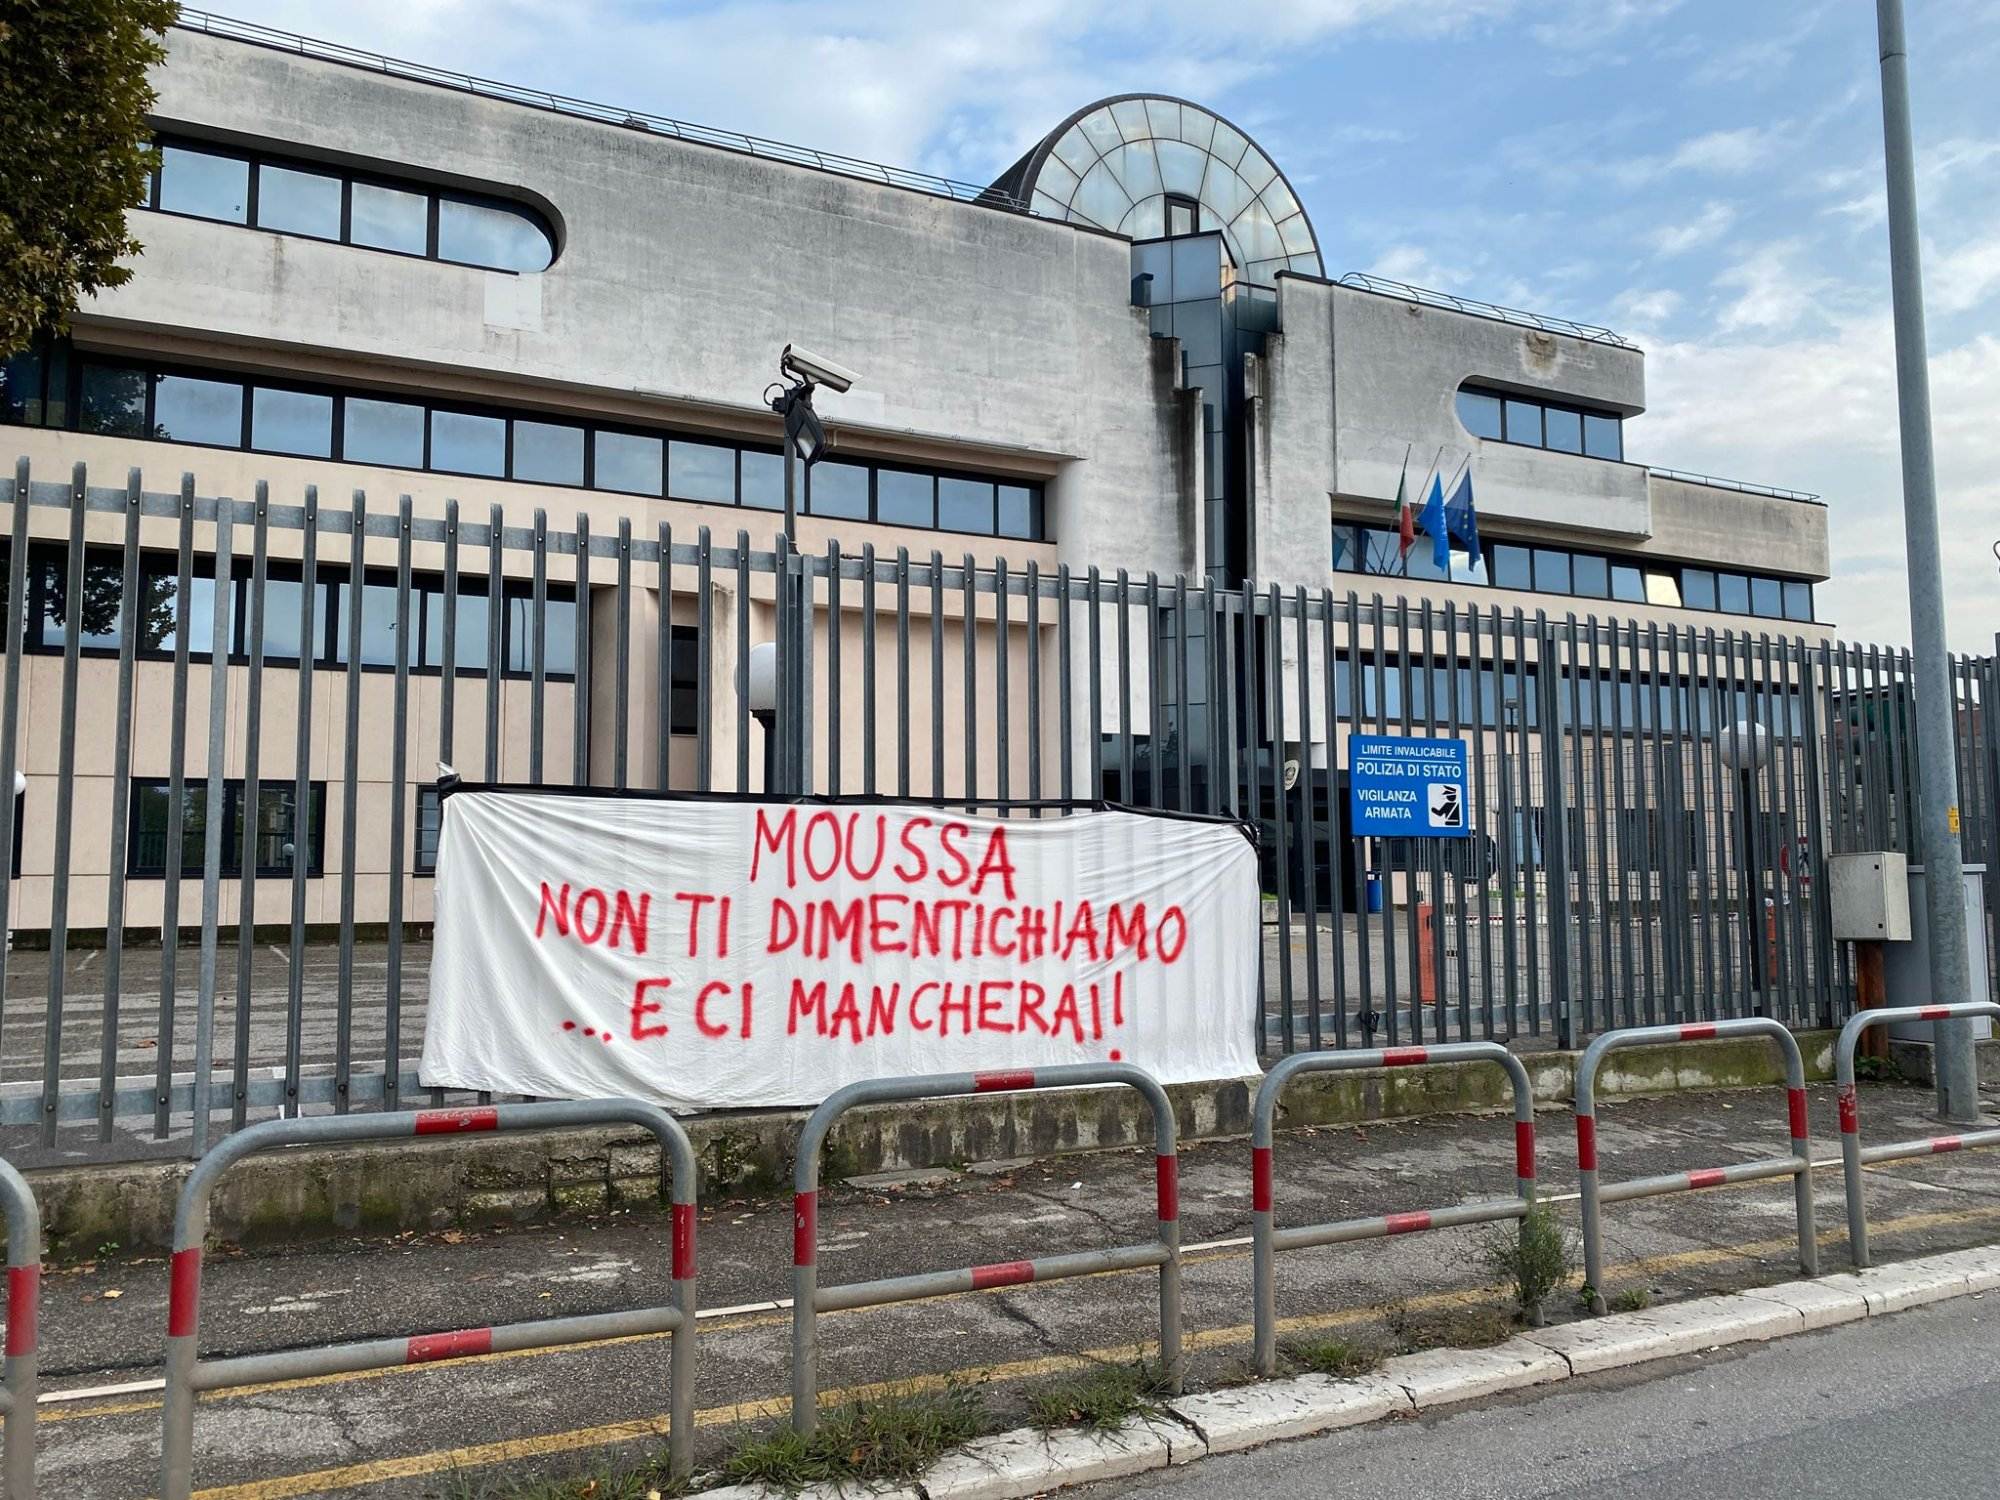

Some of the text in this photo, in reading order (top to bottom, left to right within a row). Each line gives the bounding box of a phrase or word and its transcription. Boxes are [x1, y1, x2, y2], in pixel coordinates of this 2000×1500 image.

[1361, 745, 1456, 757] LIMITE INVALICABILE
[1356, 762, 1461, 778] POLIZIA DI STATO
[1357, 789, 1417, 801] VIGILANZA
[1365, 807, 1411, 819] ARMATA
[750, 807, 1017, 902] MOUSSA
[534, 880, 1188, 966] NON TI DIMENTICHIAMO
[694, 979, 754, 1041] CI
[786, 970, 1124, 1062] MANCHERAI!
